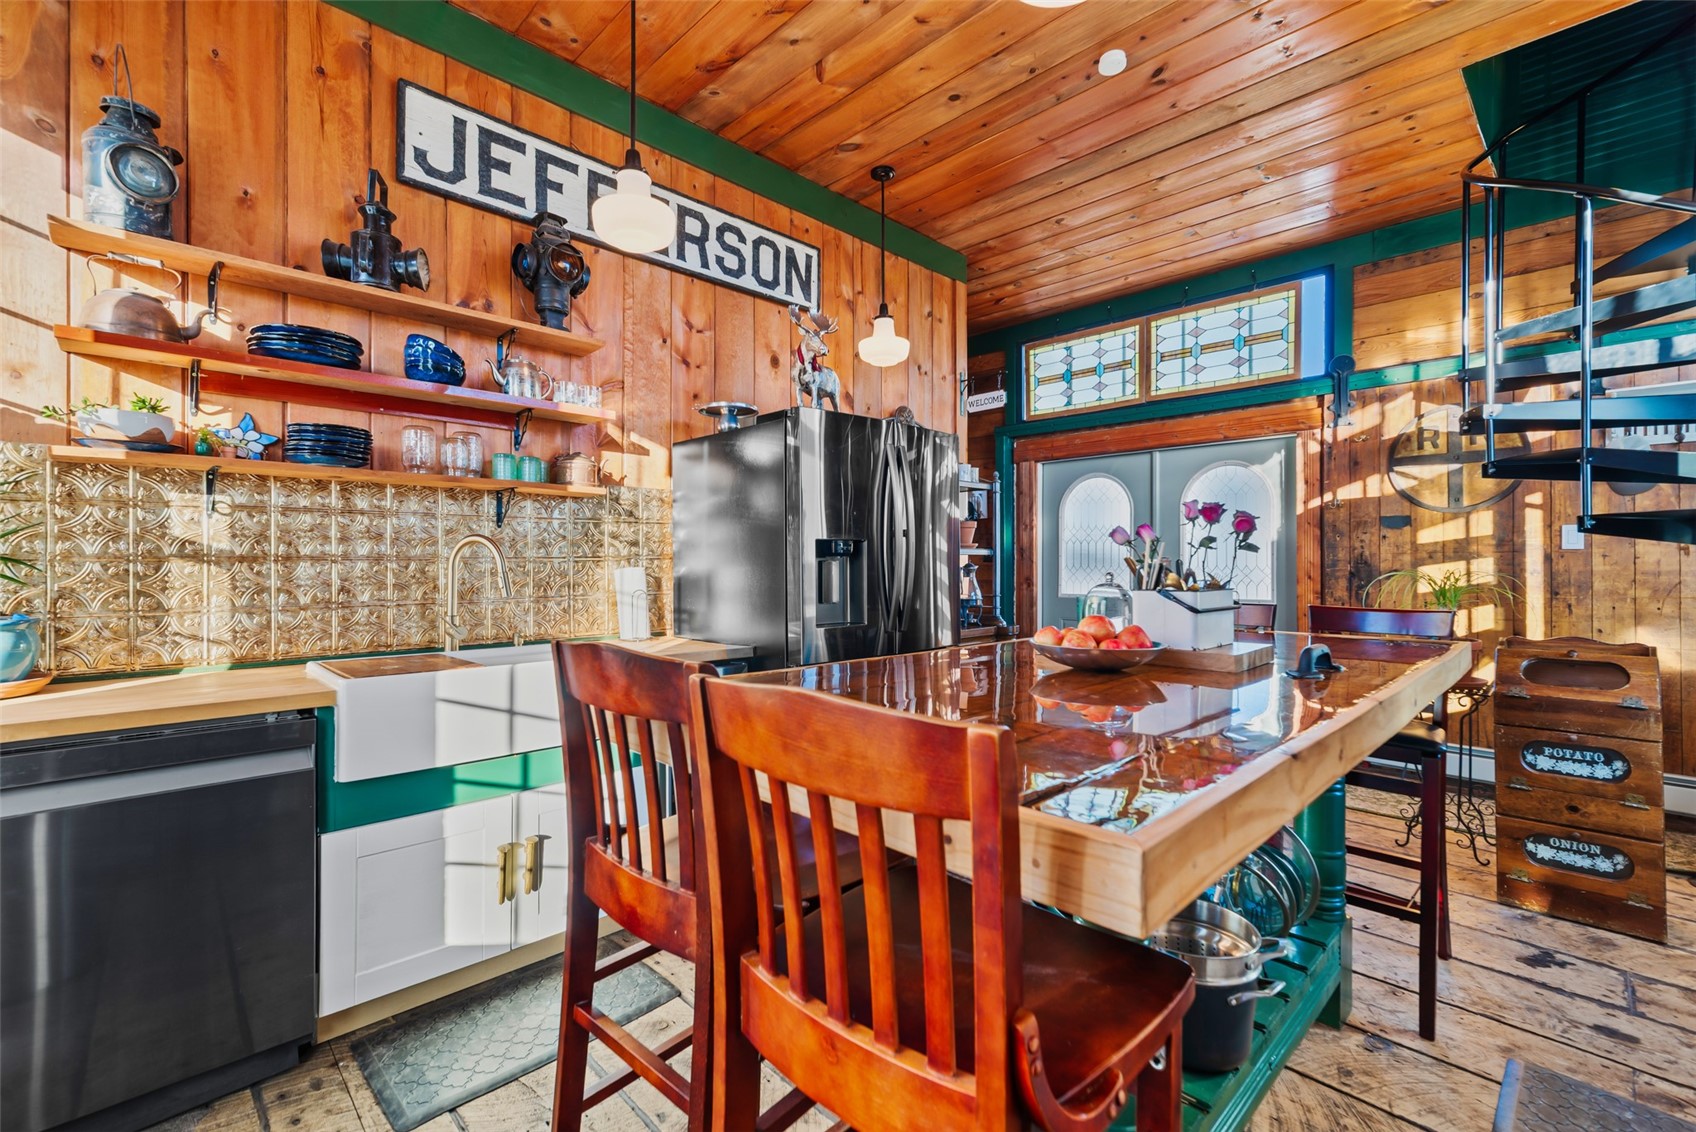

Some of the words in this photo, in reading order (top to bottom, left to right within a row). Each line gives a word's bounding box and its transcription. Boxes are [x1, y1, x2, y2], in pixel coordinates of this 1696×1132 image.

[412, 114, 814, 303] JEFFRSON
[968, 394, 1004, 409] WELCOME
[1542, 746, 1605, 764] POTATO
[1549, 837, 1602, 855] ONION
